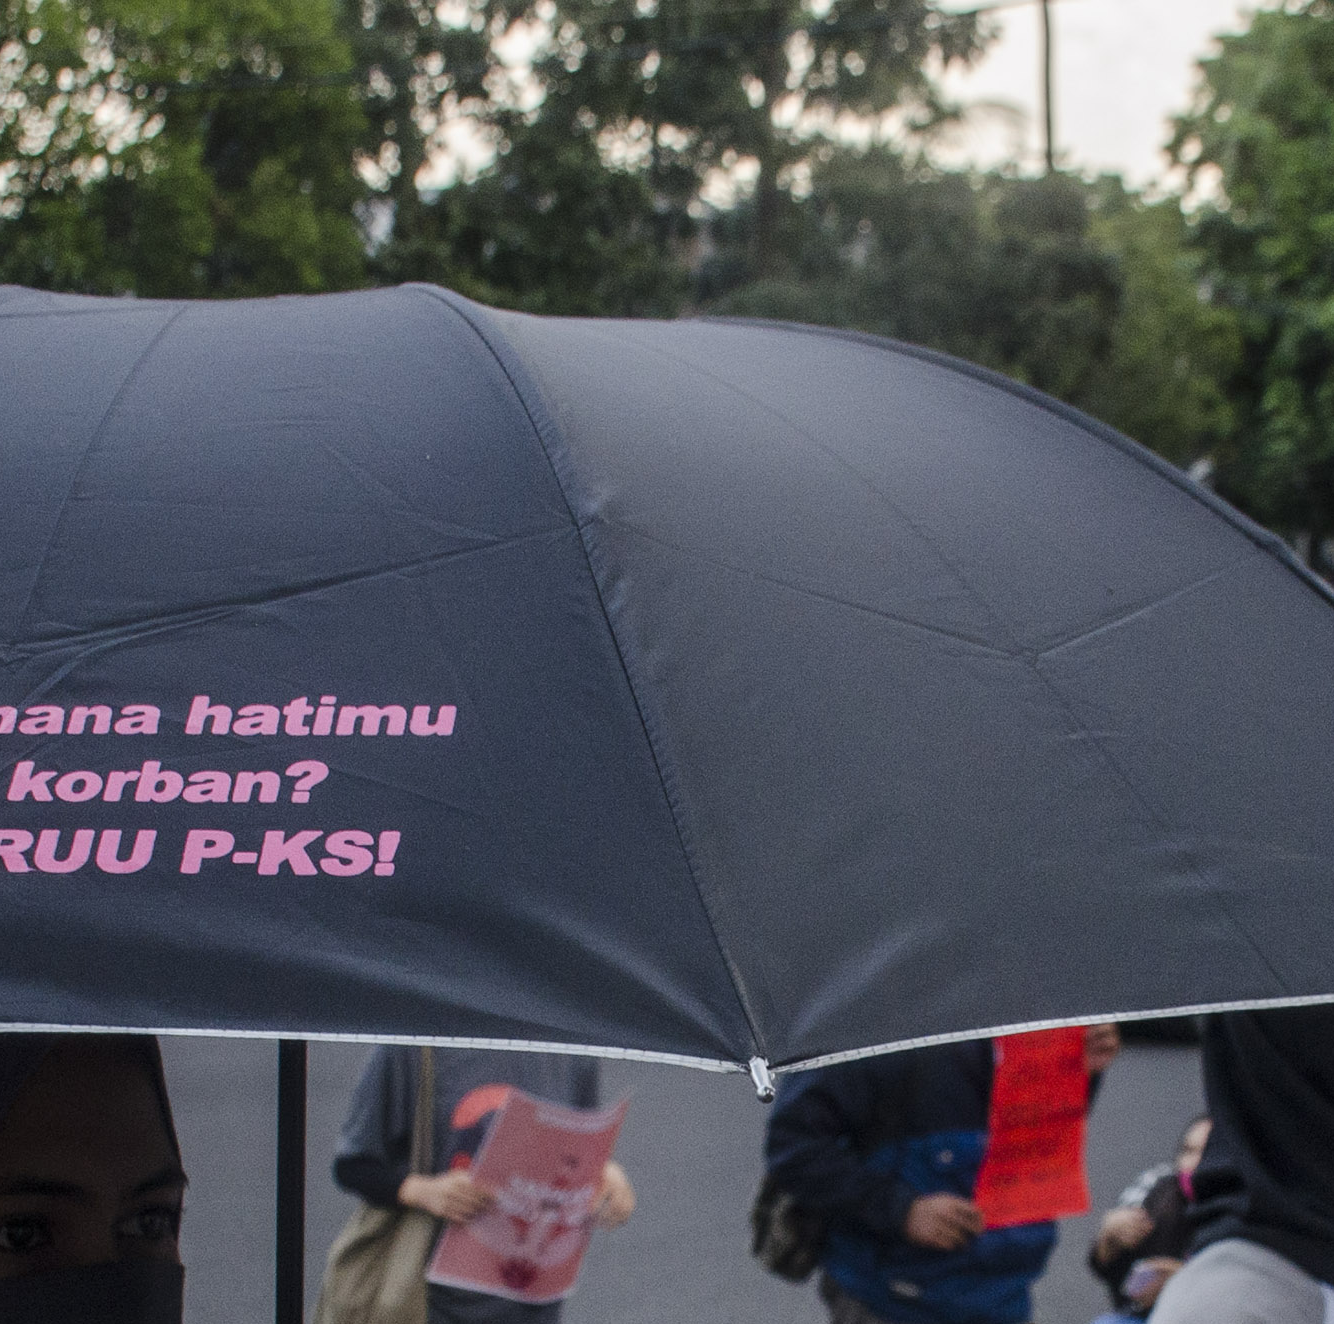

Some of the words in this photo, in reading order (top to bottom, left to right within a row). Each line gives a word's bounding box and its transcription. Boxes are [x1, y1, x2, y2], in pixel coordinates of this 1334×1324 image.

[184, 694, 457, 736] hatimu
[6, 759, 330, 804] korban?
[179, 828, 402, 877] P-KS!
